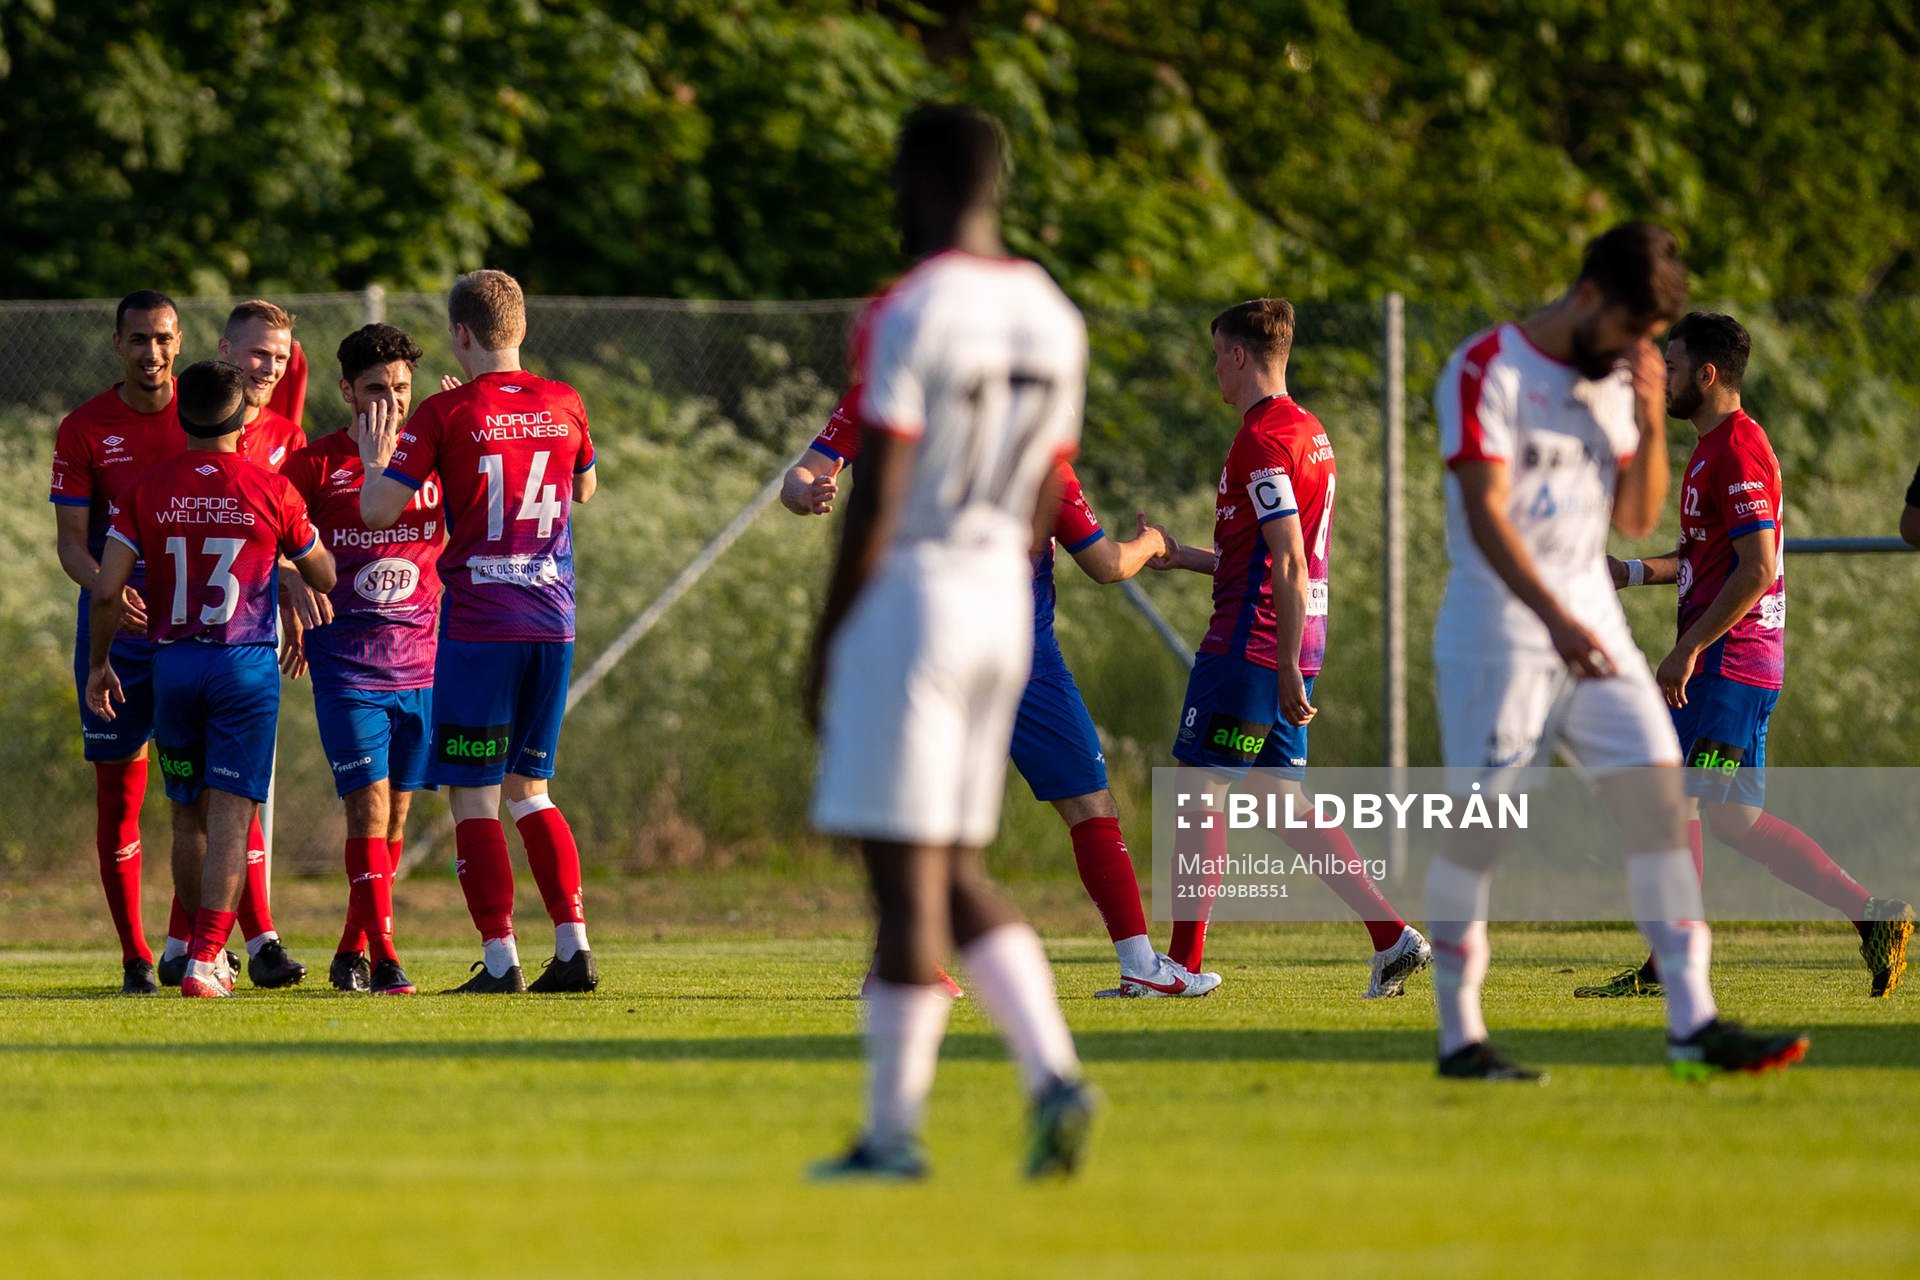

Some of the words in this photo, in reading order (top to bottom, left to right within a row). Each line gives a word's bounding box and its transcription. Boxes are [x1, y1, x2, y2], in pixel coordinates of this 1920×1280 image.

[486, 411, 552, 428] NORDIC
[471, 424, 570, 442] WELLNESS
[171, 496, 237, 511] NORDIC
[414, 480, 439, 510] 10
[477, 450, 562, 542] 14
[1255, 481, 1282, 511] C
[156, 511, 255, 526] WELLNESS
[1314, 472, 1336, 561] 8
[1735, 499, 1768, 515] thom
[333, 524, 420, 549] Höganäs
[497, 561, 541, 575] OLSSONS
[165, 536, 247, 625] 13
[365, 569, 412, 591] SBB
[1185, 707, 1198, 730] 8
[446, 735, 497, 758] akea
[1214, 727, 1265, 754] akea
